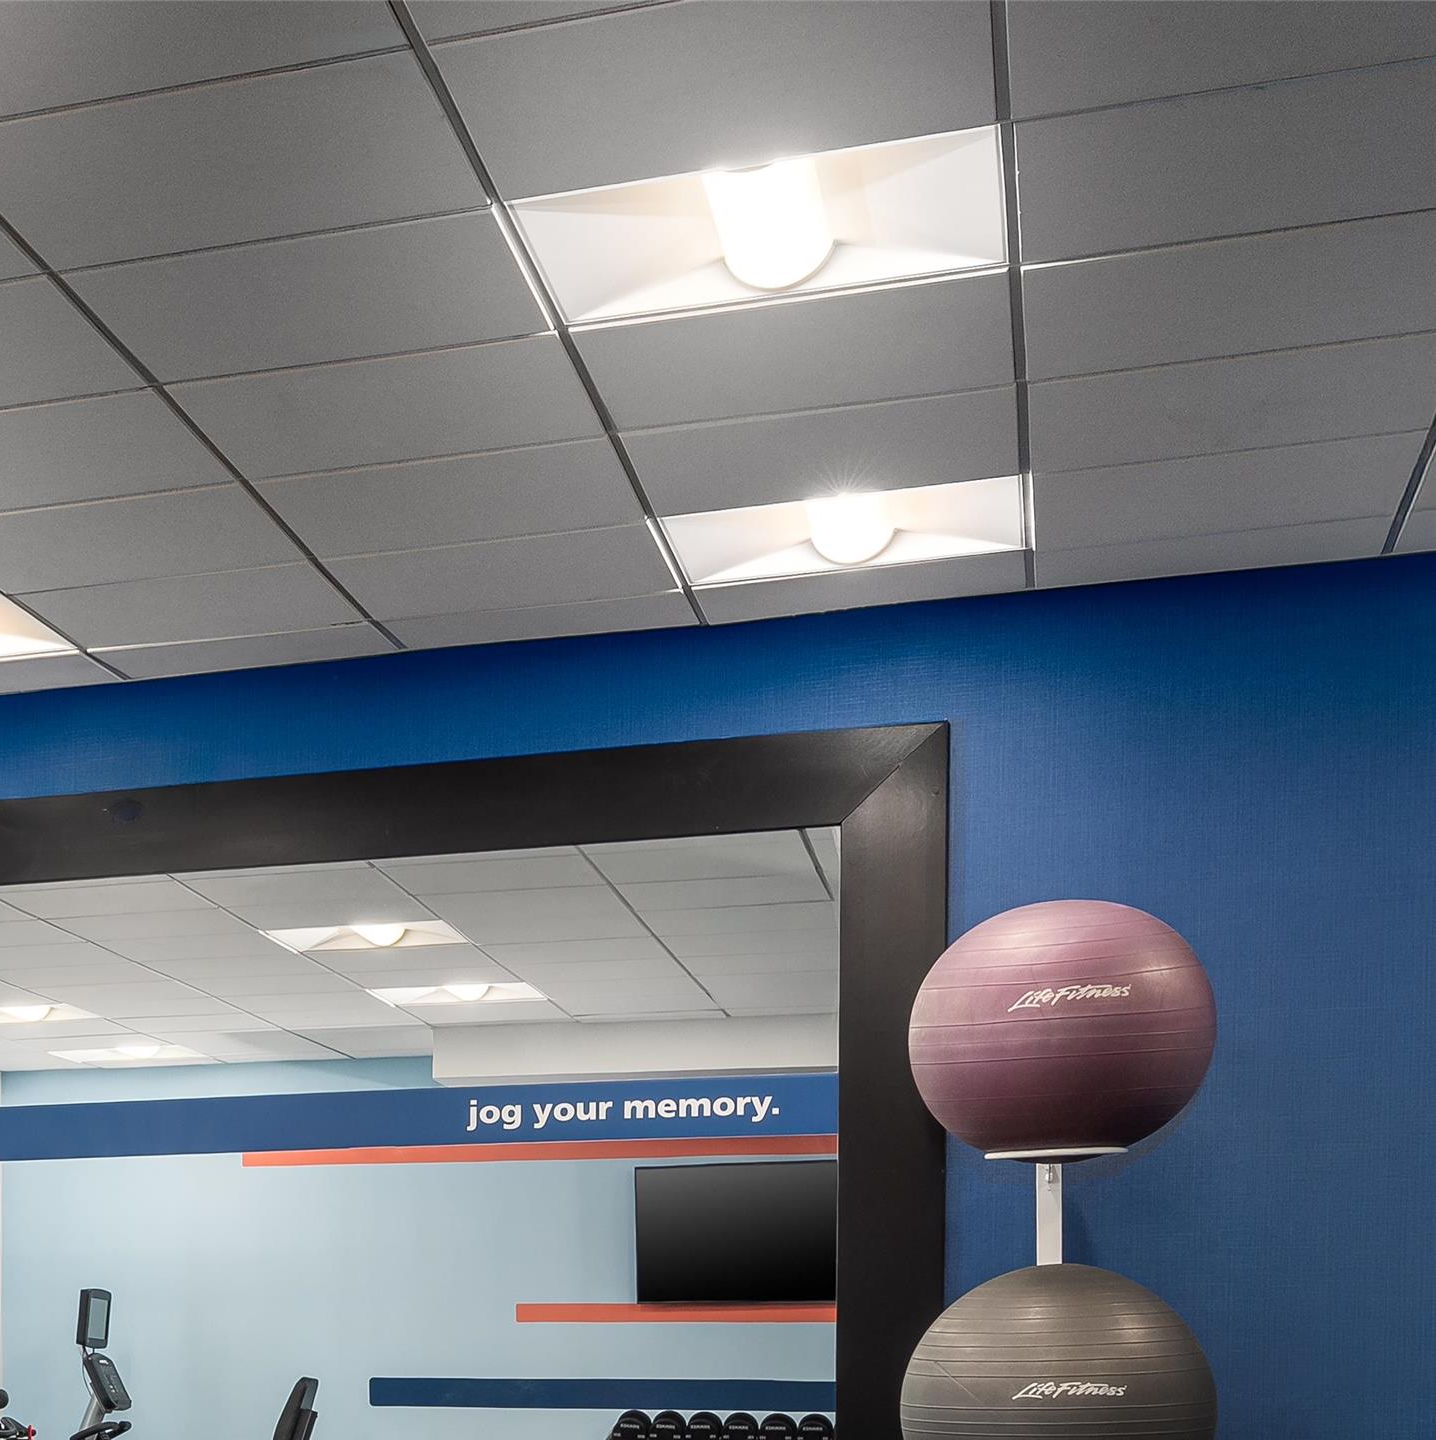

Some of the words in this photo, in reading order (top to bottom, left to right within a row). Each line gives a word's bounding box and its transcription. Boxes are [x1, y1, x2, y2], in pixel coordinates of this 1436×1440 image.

[466, 1099, 522, 1131] jog
[532, 1099, 613, 1129] your
[623, 1095, 780, 1123] memory.
